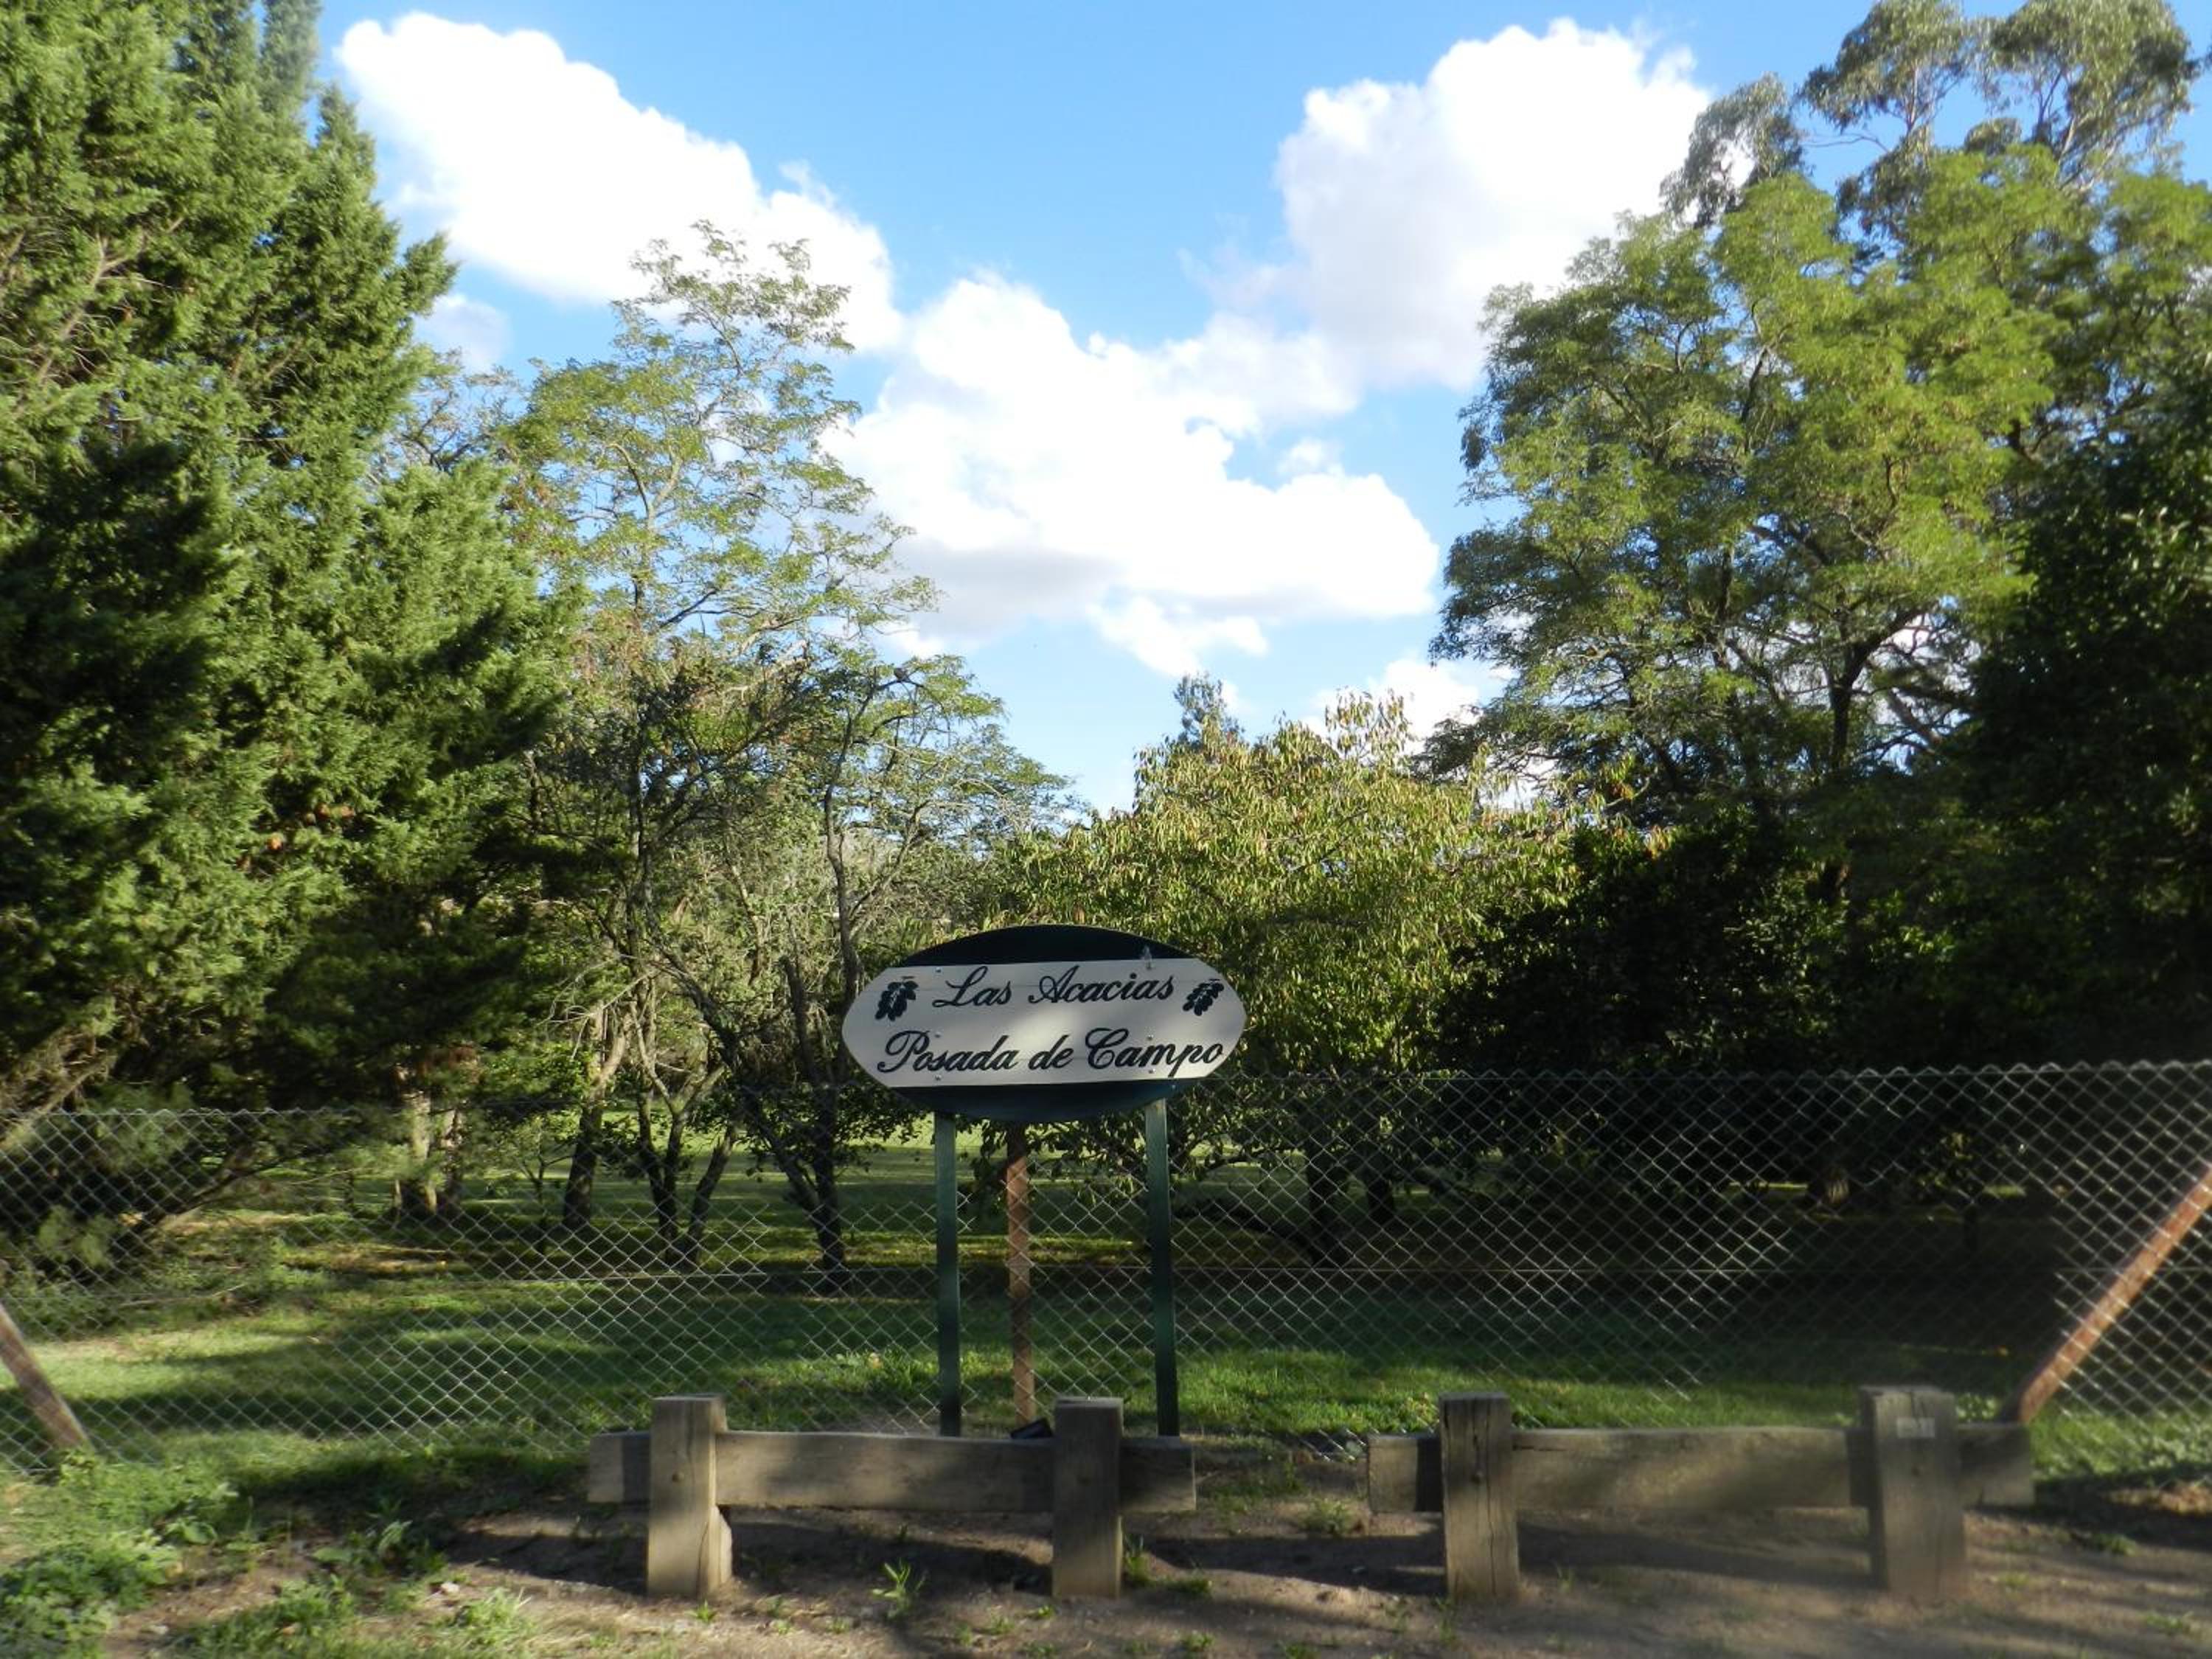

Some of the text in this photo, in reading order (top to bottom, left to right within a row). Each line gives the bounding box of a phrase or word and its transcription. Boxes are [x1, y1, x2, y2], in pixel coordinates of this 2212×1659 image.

[932, 965, 1175, 1007] Las Acacias
[877, 1027, 1224, 1078] Posada de Campo
